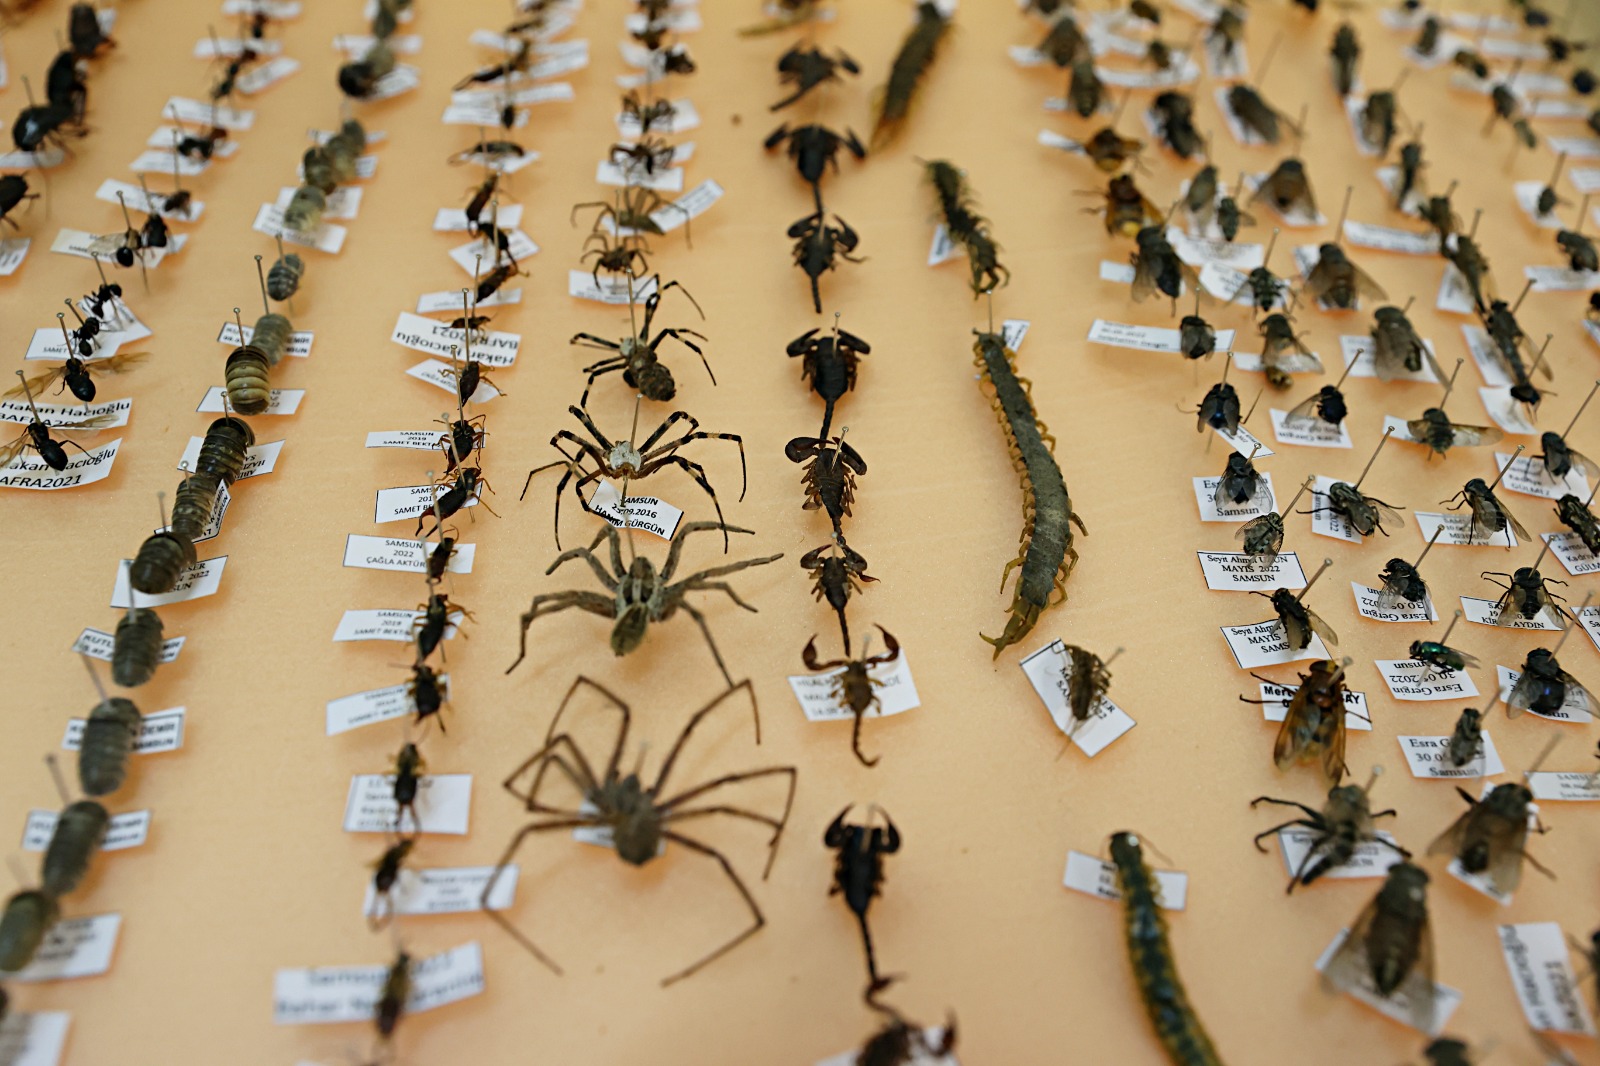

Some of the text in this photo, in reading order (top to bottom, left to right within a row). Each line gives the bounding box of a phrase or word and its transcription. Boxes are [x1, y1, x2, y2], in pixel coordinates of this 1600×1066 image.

[410, 486, 445, 495] SAMSN
[394, 505, 421, 515] SAMET
[1216, 507, 1259, 516] Samsun
[624, 518, 665, 536] GÜRGÜN
[384, 540, 424, 550] SAMSUN
[393, 549, 415, 558] 2022
[365, 556, 395, 565] ÇAĞLA
[1206, 554, 1229, 564] Seyit
[1221, 564, 1281, 573] MAYIS 2022
[188, 570, 210, 580] 2022
[1232, 574, 1276, 582] SAMSUN
[1401, 612, 1429, 621] Esra
[1230, 627, 1253, 637] Seyit
[1247, 633, 1282, 645] MAYIS
[1391, 682, 1465, 696] Esra Gergin
[1408, 738, 1438, 748] Esra
[1428, 766, 1479, 777] Samsun
